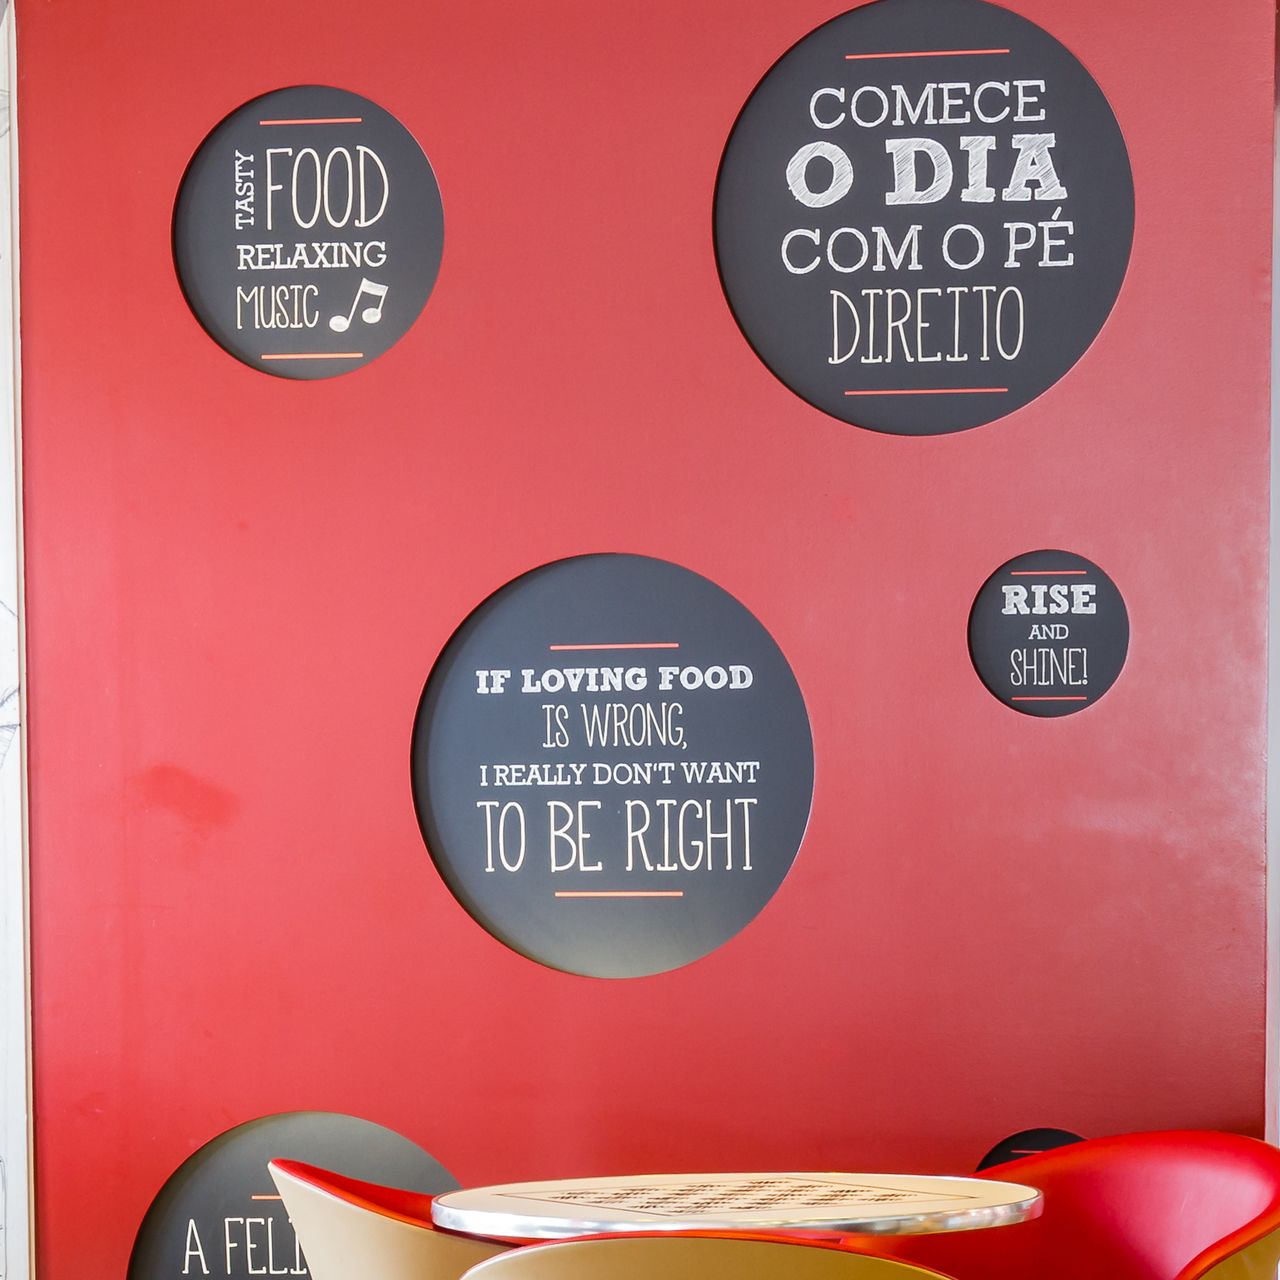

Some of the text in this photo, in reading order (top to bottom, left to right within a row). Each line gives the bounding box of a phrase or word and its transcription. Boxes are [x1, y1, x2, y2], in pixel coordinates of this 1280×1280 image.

[810, 80, 1046, 129] COMECE
[235, 145, 389, 230] TASTY FOOD
[785, 133, 1068, 208] O DIA
[236, 241, 388, 270] RELAXING
[781, 206, 1074, 275] COM O PÉ
[236, 284, 319, 329] MUSIC
[828, 286, 1024, 364] DIREITO
[1001, 584, 1097, 615] RISE
[1028, 624, 1069, 640] AND
[476, 665, 753, 694] IF LOVING FOOD
[1010, 647, 1088, 686] SHINE!
[542, 702, 688, 750] IS WRONG,
[480, 765, 488, 787] I
[493, 763, 587, 786] REALLY
[681, 761, 760, 784] WANT
[476, 798, 757, 873] TO BE RIGHT
[182, 1218, 210, 1275] A
